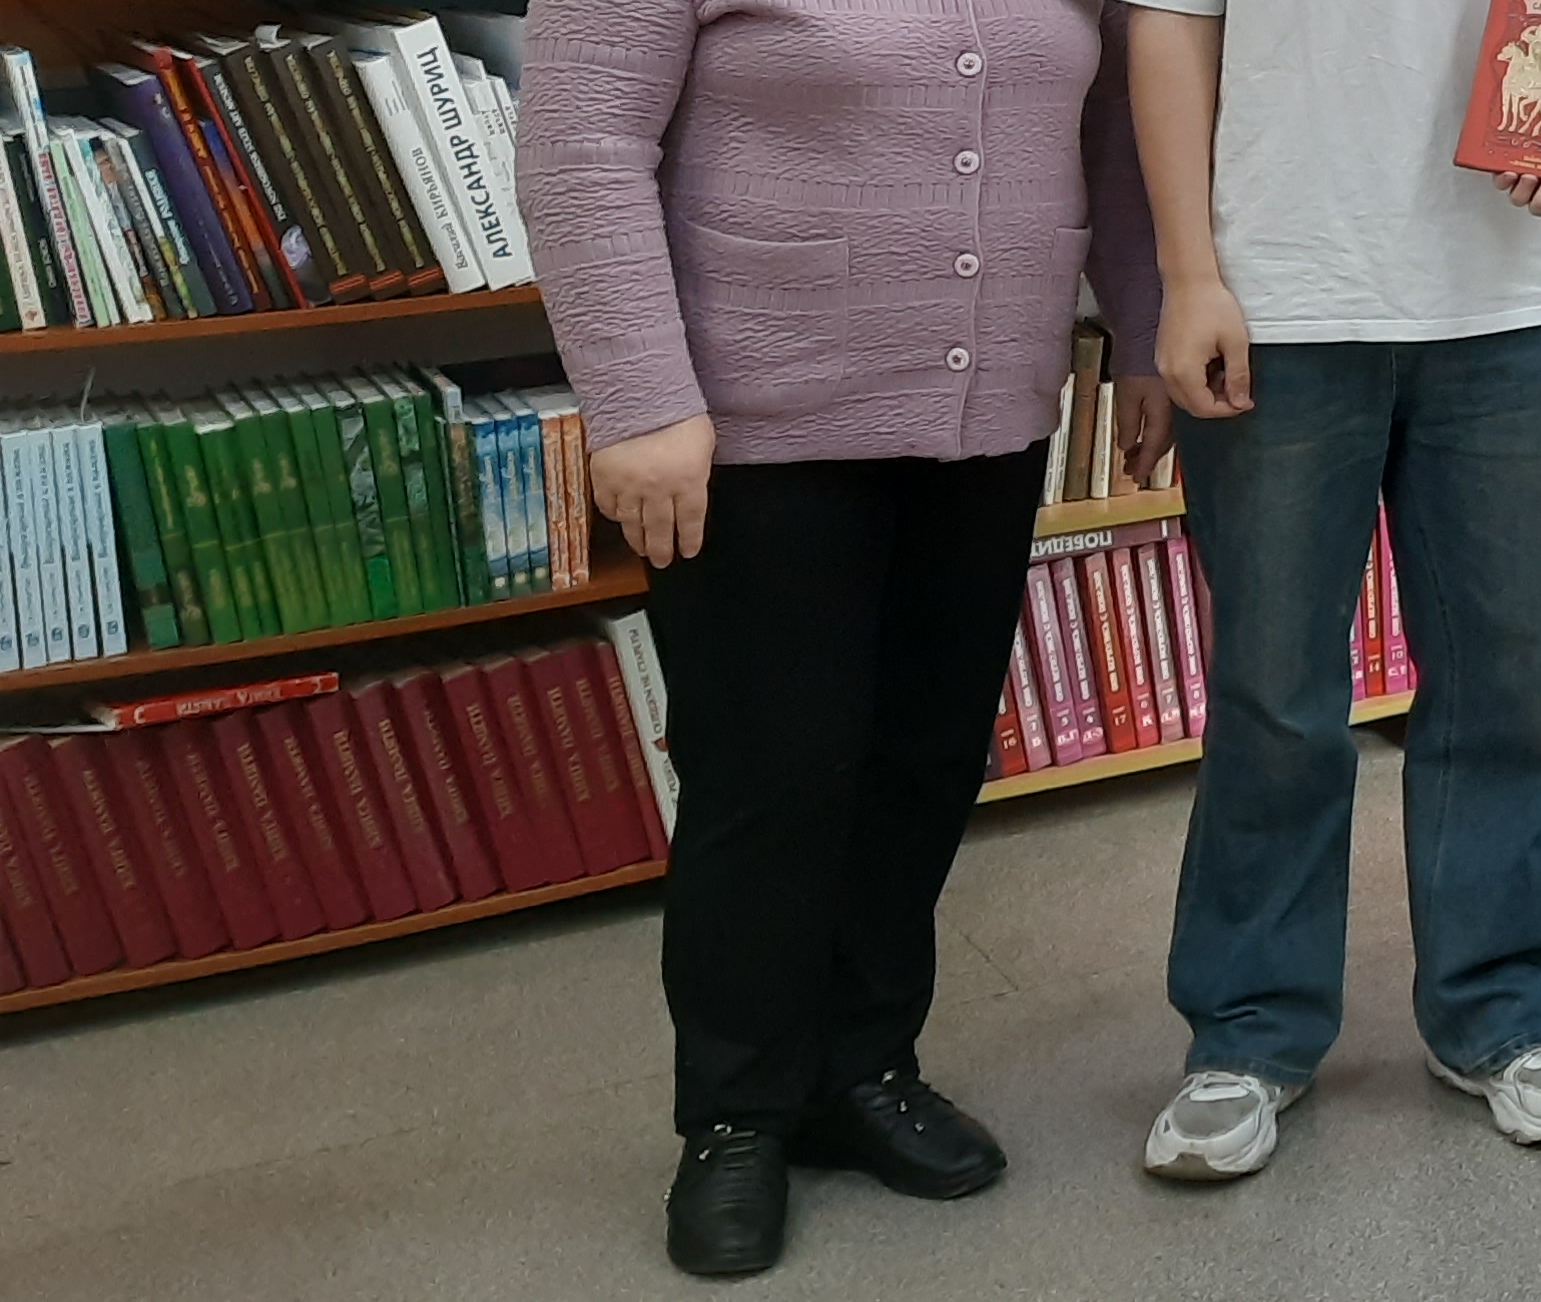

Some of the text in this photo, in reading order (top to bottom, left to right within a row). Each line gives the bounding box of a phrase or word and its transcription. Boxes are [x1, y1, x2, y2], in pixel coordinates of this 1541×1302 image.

[411, 147, 448, 220] КИРЬЯНОВ
[416, 46, 513, 260] АЛЕКСАНДР ШУРИЦ
[1113, 714, 1127, 726] 17
